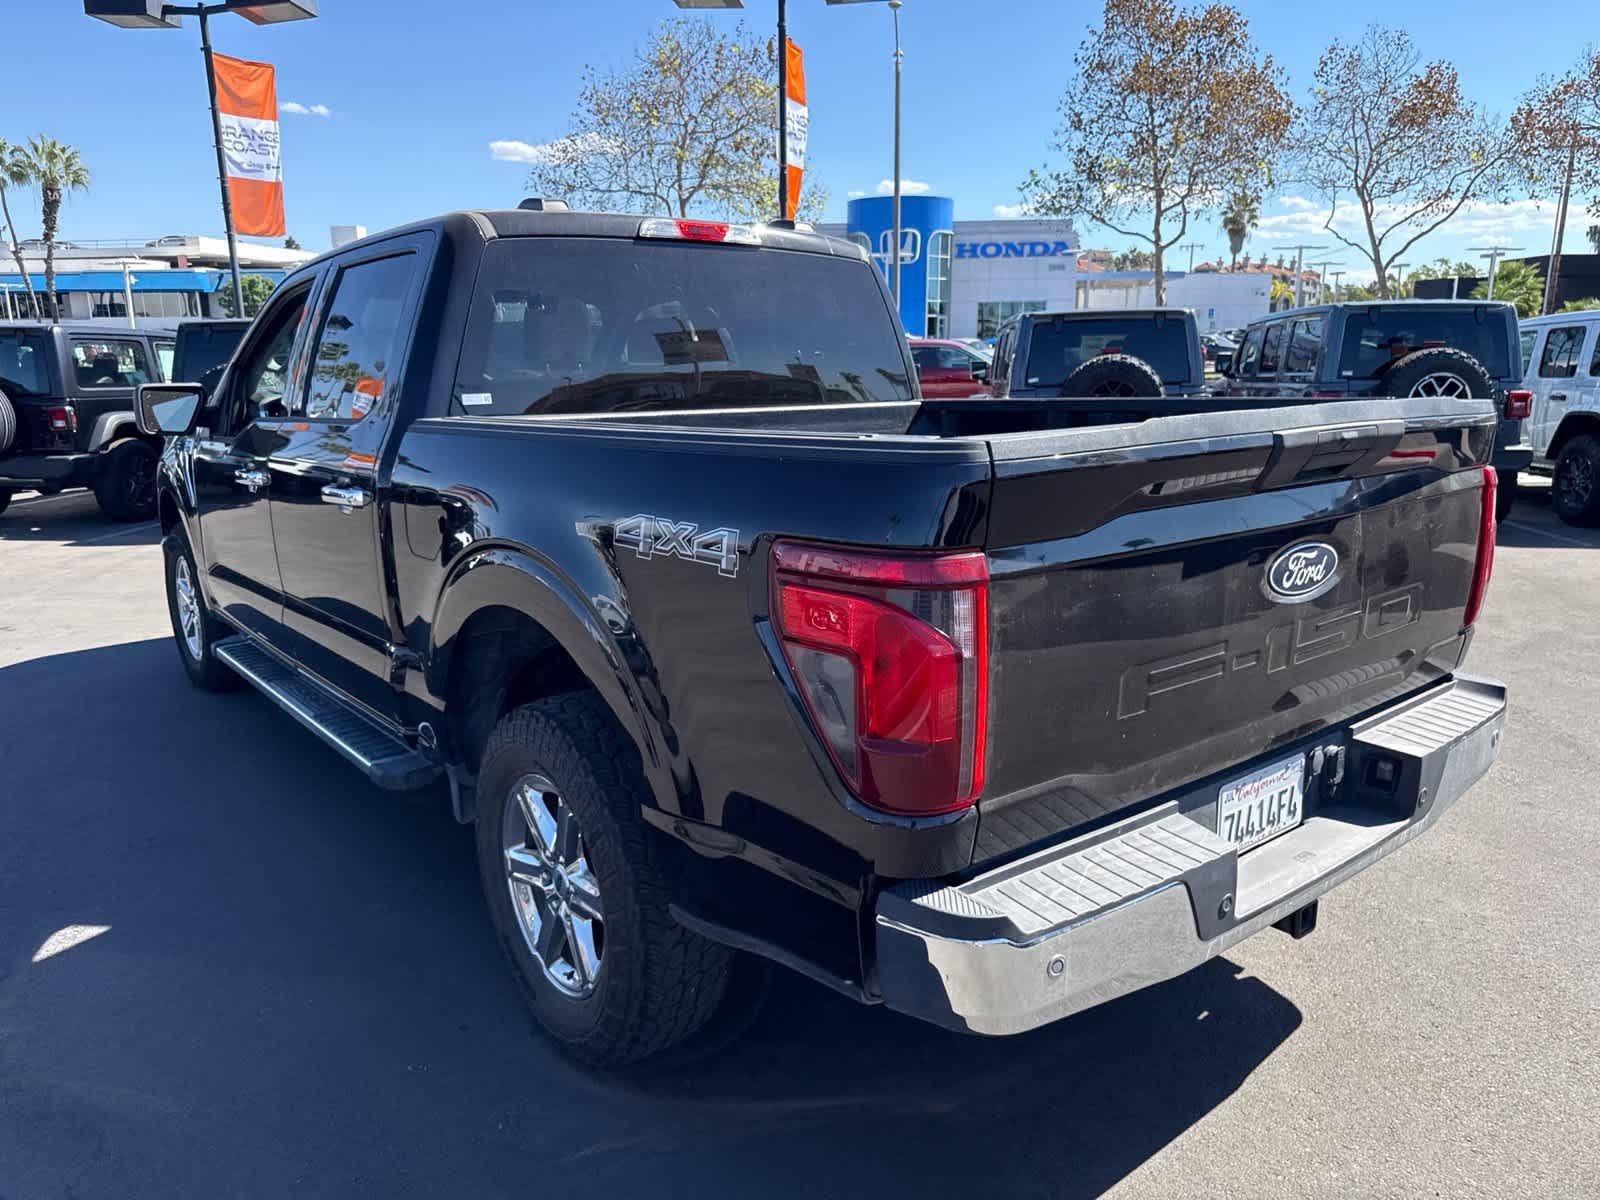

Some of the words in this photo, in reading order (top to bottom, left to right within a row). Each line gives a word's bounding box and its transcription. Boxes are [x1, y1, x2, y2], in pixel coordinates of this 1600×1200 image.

[222, 125, 279, 143] RANGE
[223, 139, 277, 157] COAST
[955, 241, 1072, 259] HONDA
[1283, 550, 1327, 588] Ford
[1116, 582, 1424, 720] F-150
[1223, 785, 1298, 843] 74414F4
